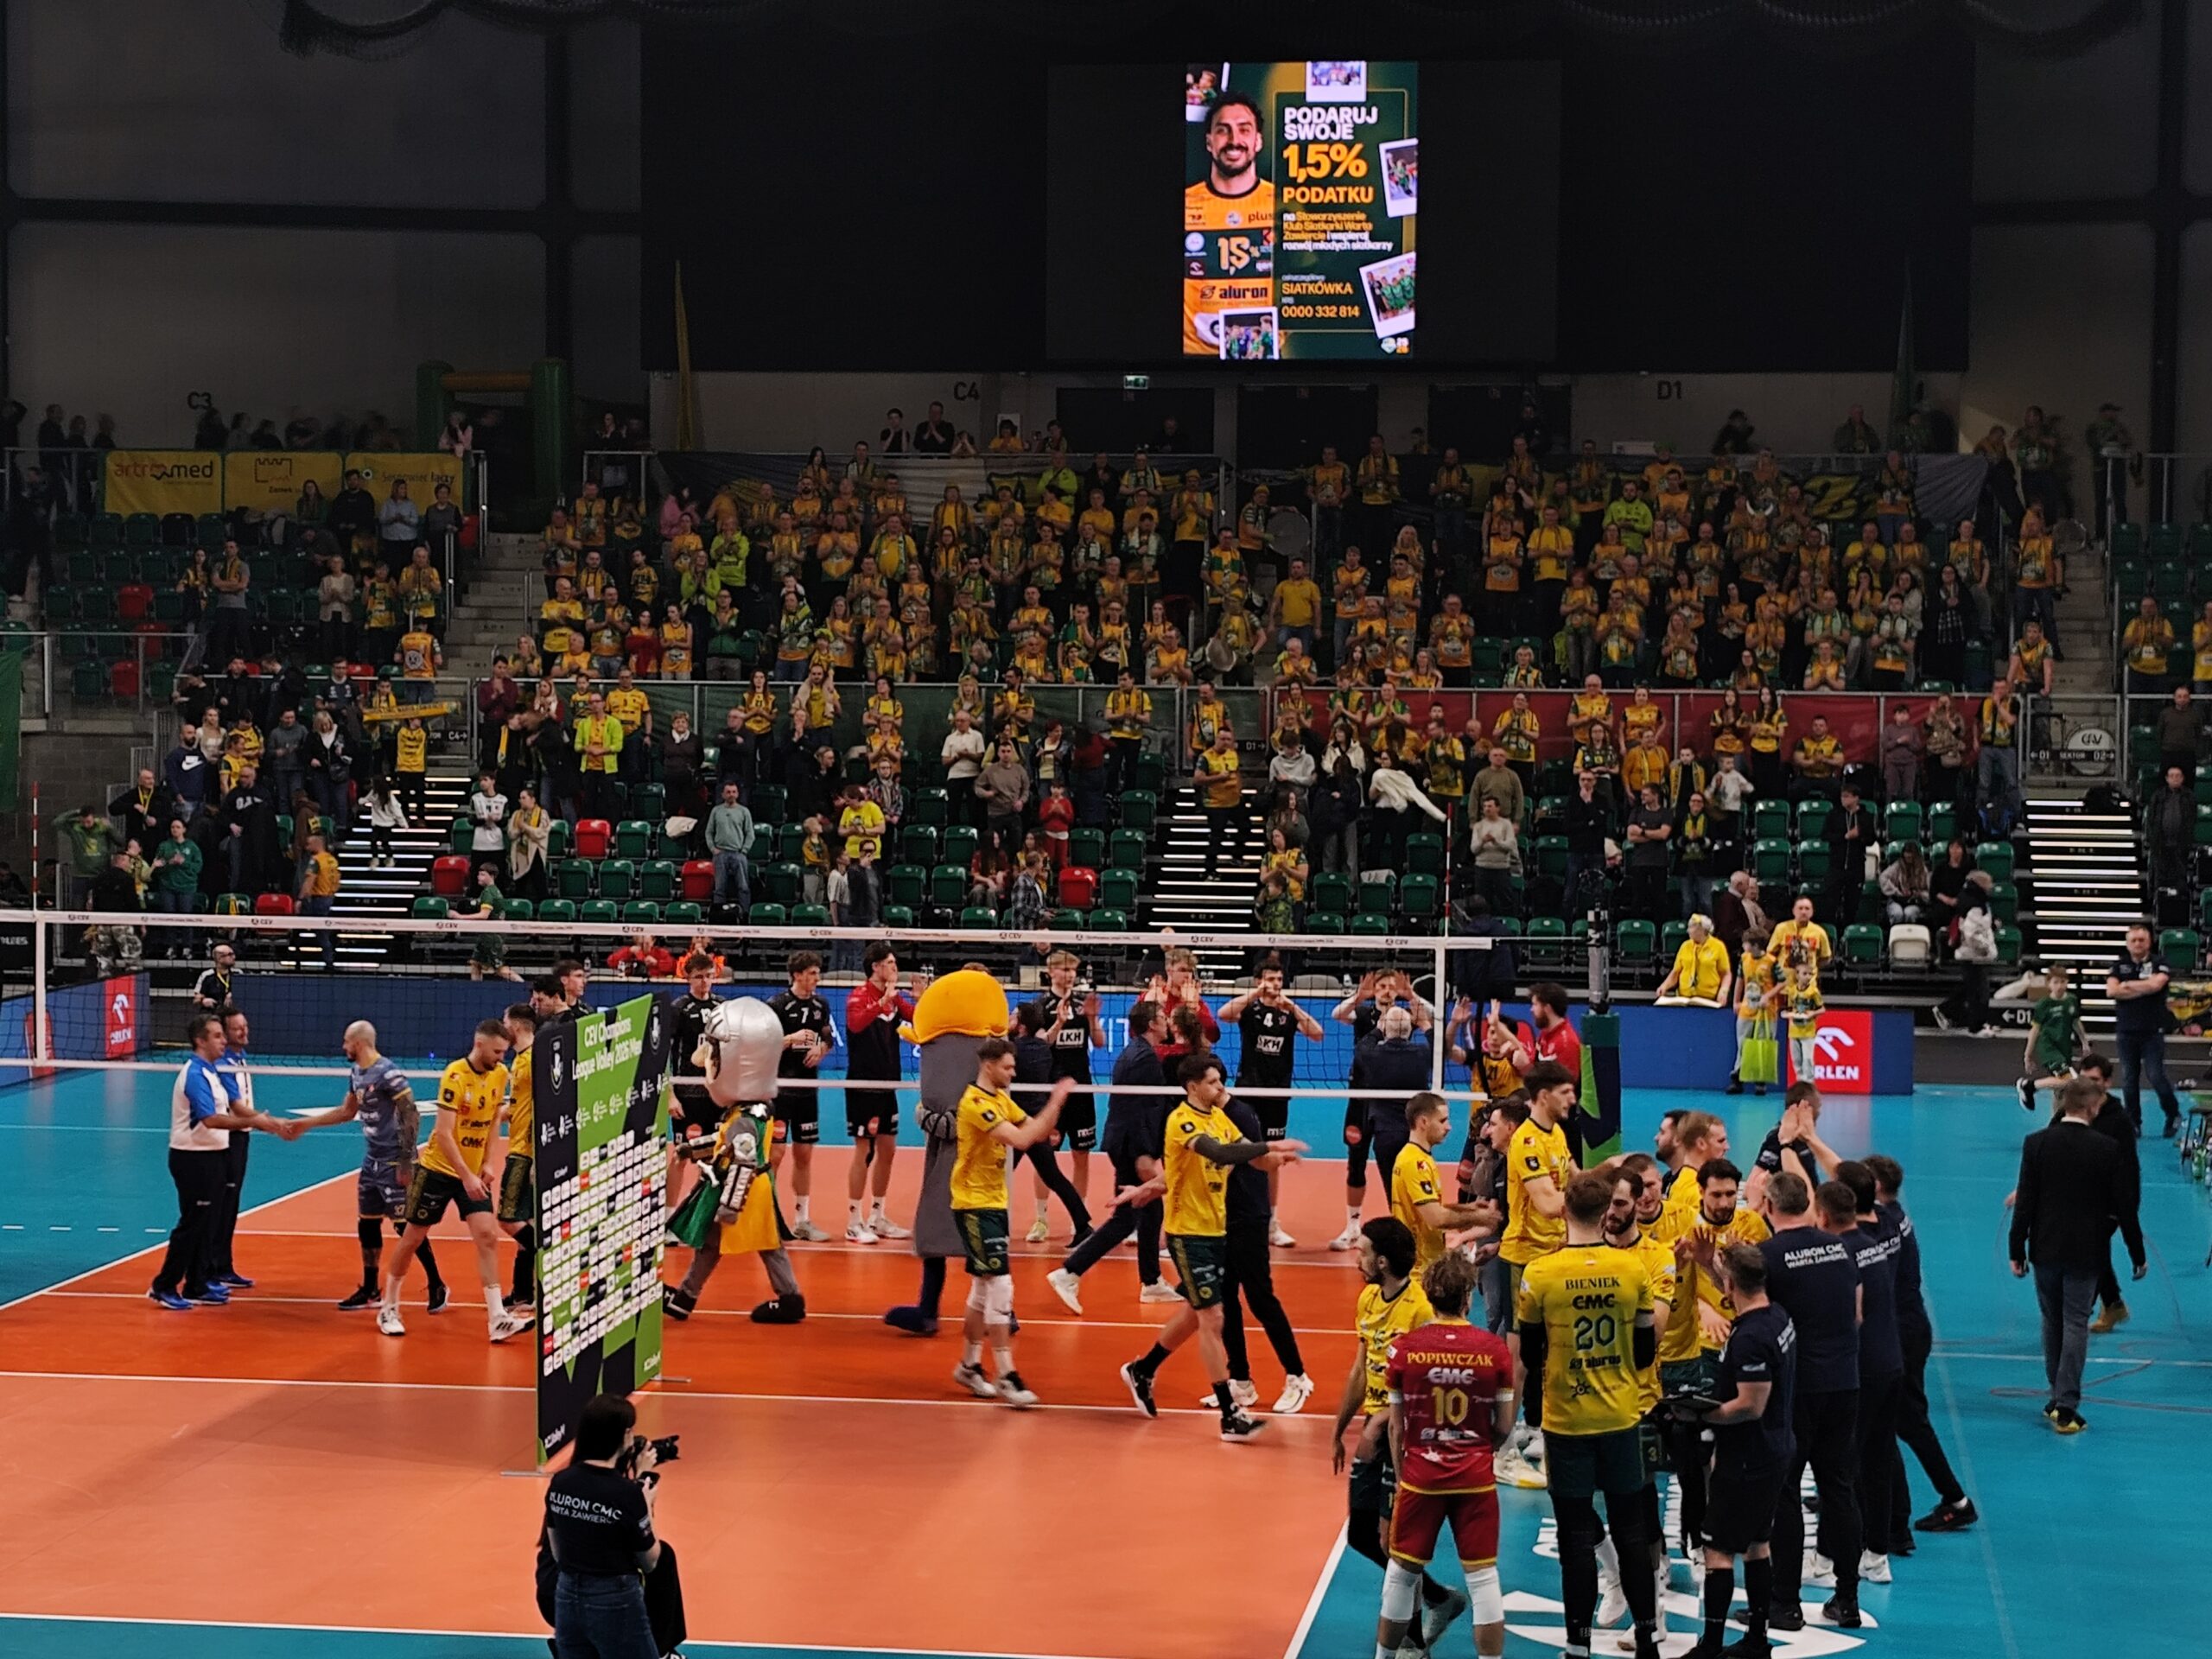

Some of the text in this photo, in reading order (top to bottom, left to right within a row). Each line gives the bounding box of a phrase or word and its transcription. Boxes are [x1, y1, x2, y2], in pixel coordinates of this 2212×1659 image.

[1284, 106, 1378, 125] PODARUJ
[1284, 124, 1355, 141] SWOJE
[1282, 143, 1369, 184] 1,5%
[1283, 186, 1374, 204] PODATKU
[1218, 285, 1268, 299] aluron
[1281, 281, 1354, 295] SIATKÓWKA
[1281, 305, 1361, 318] 0000 332 814
[953, 381, 980, 401] C4
[1657, 380, 1682, 400] D1
[801, 1007, 810, 1023] 7
[1262, 1013, 1274, 1027] 4
[2016, 1008, 2031, 1025] D1
[584, 1014, 632, 1048] CEV Champions
[1058, 1030, 1082, 1043] LKH
[572, 1058, 595, 1082] League
[594, 1046, 615, 1071] Volley
[1814, 1065, 1859, 1080] RLEN
[1784, 1245, 1826, 1262] ALURON
[1565, 1275, 1620, 1291] BIENIEK
[1572, 1293, 1615, 1310] CMC
[1573, 1313, 1616, 1352] 20
[1407, 1351, 1494, 1367] POPIWCZAK
[1427, 1367, 1474, 1384] CMC
[1431, 1385, 1470, 1426] 10
[591, 1502, 623, 1521] CMC
